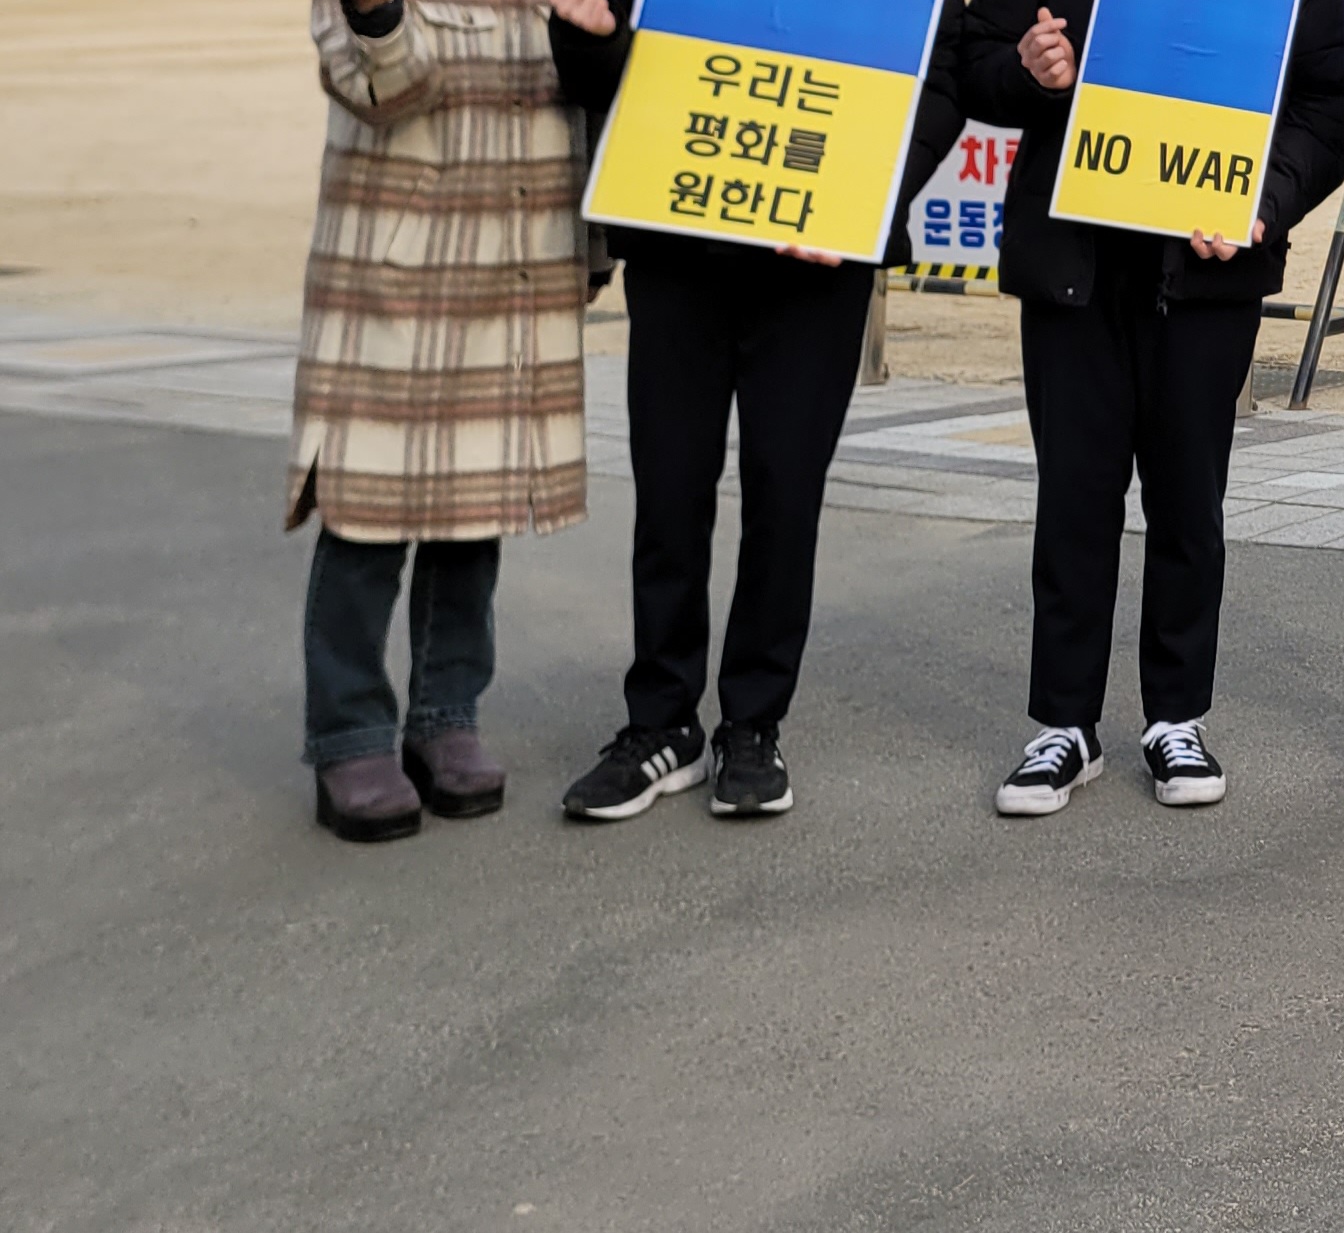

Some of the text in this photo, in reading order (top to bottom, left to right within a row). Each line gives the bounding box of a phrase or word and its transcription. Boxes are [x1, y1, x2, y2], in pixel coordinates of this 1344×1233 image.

[698, 54, 840, 116] 우리는
[684, 111, 827, 174] 평화를
[1074, 129, 1254, 196] NO WAR
[669, 170, 814, 233] 원한다
